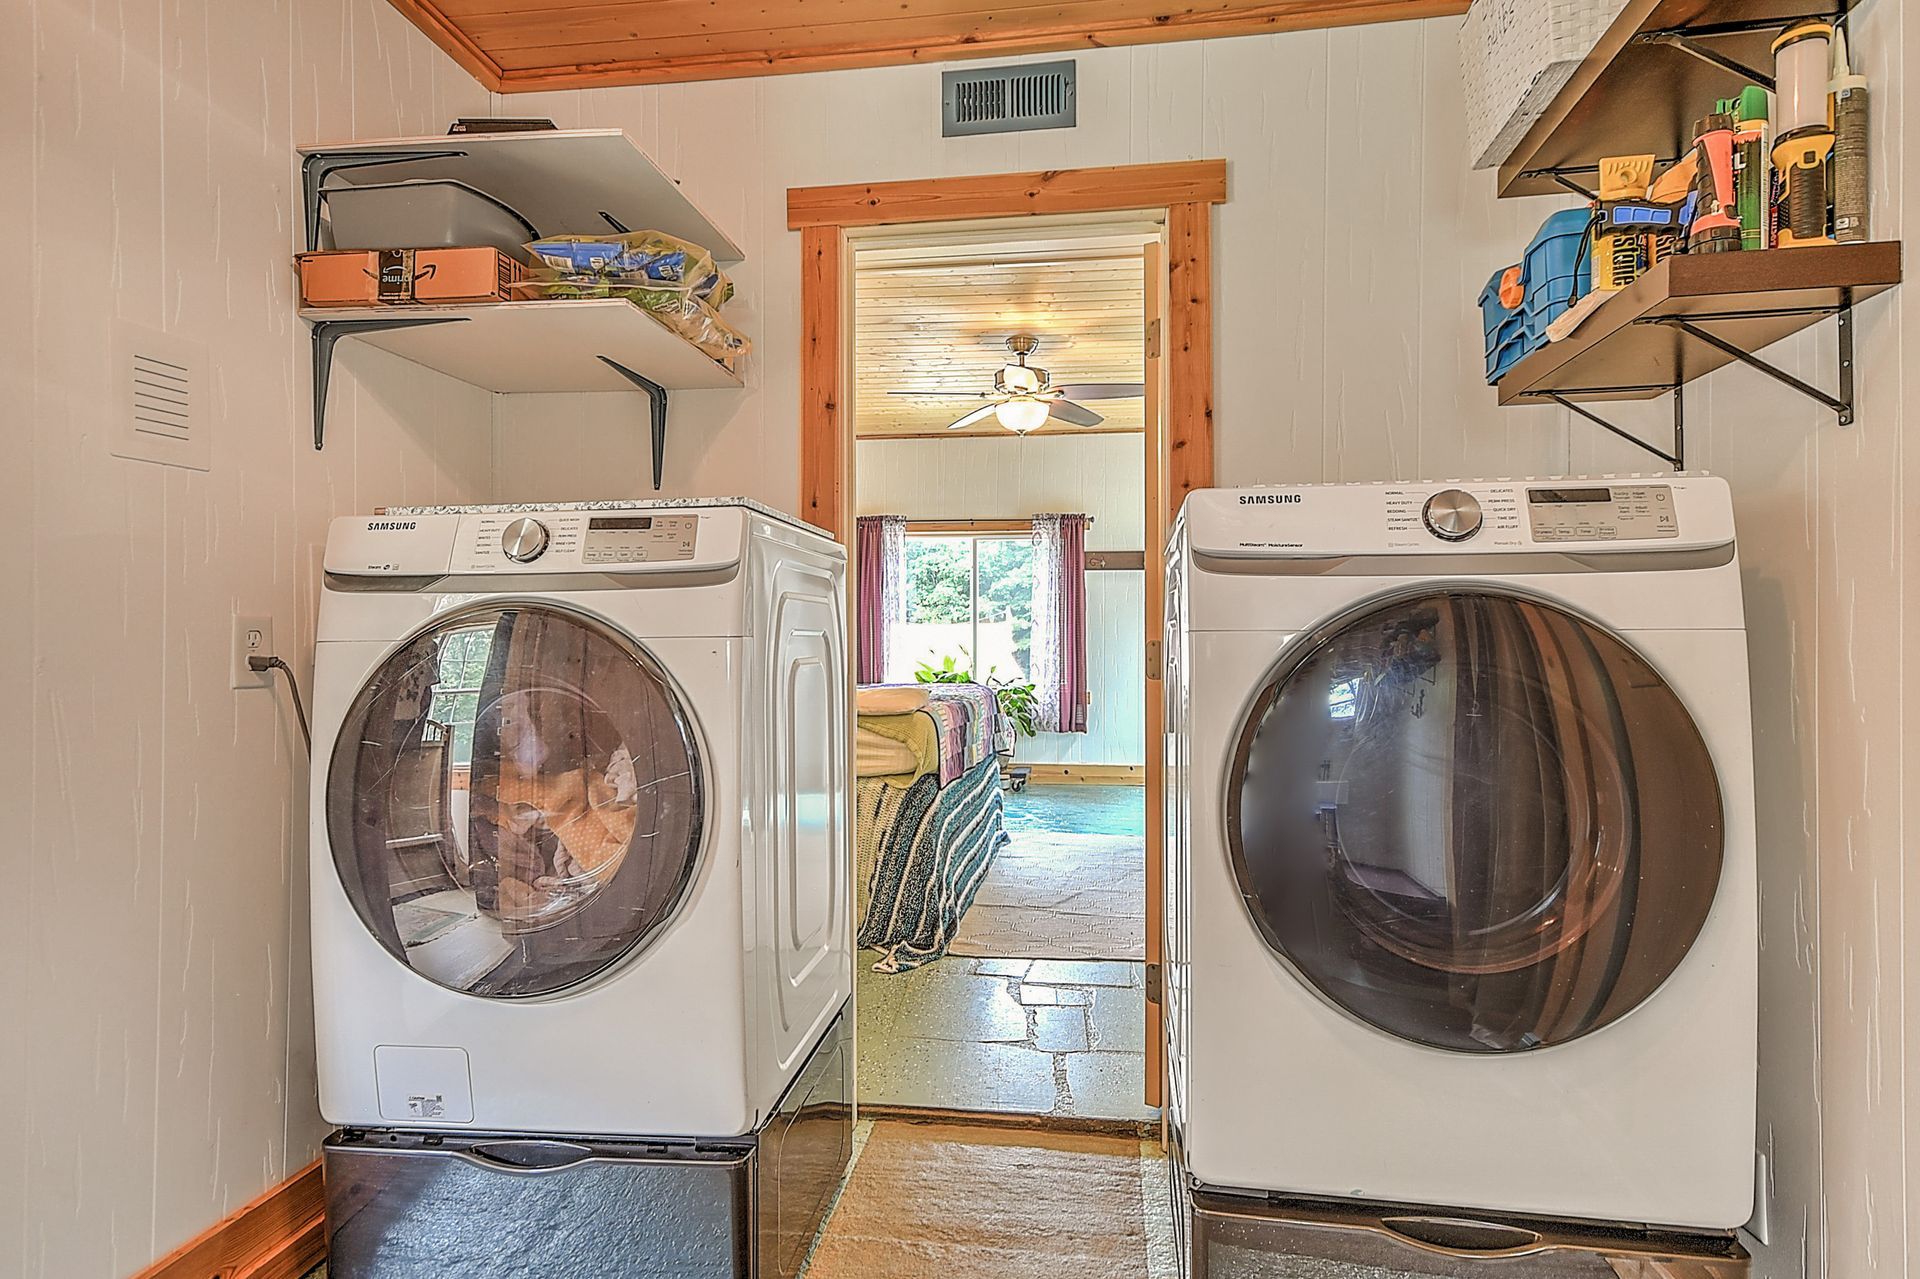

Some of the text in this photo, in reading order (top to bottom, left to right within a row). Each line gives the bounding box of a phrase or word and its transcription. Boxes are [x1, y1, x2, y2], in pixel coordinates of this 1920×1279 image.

[1612, 234, 1640, 287] stone
[1239, 494, 1302, 505] SAMSUNG
[367, 522, 417, 531] SAMSUNG
